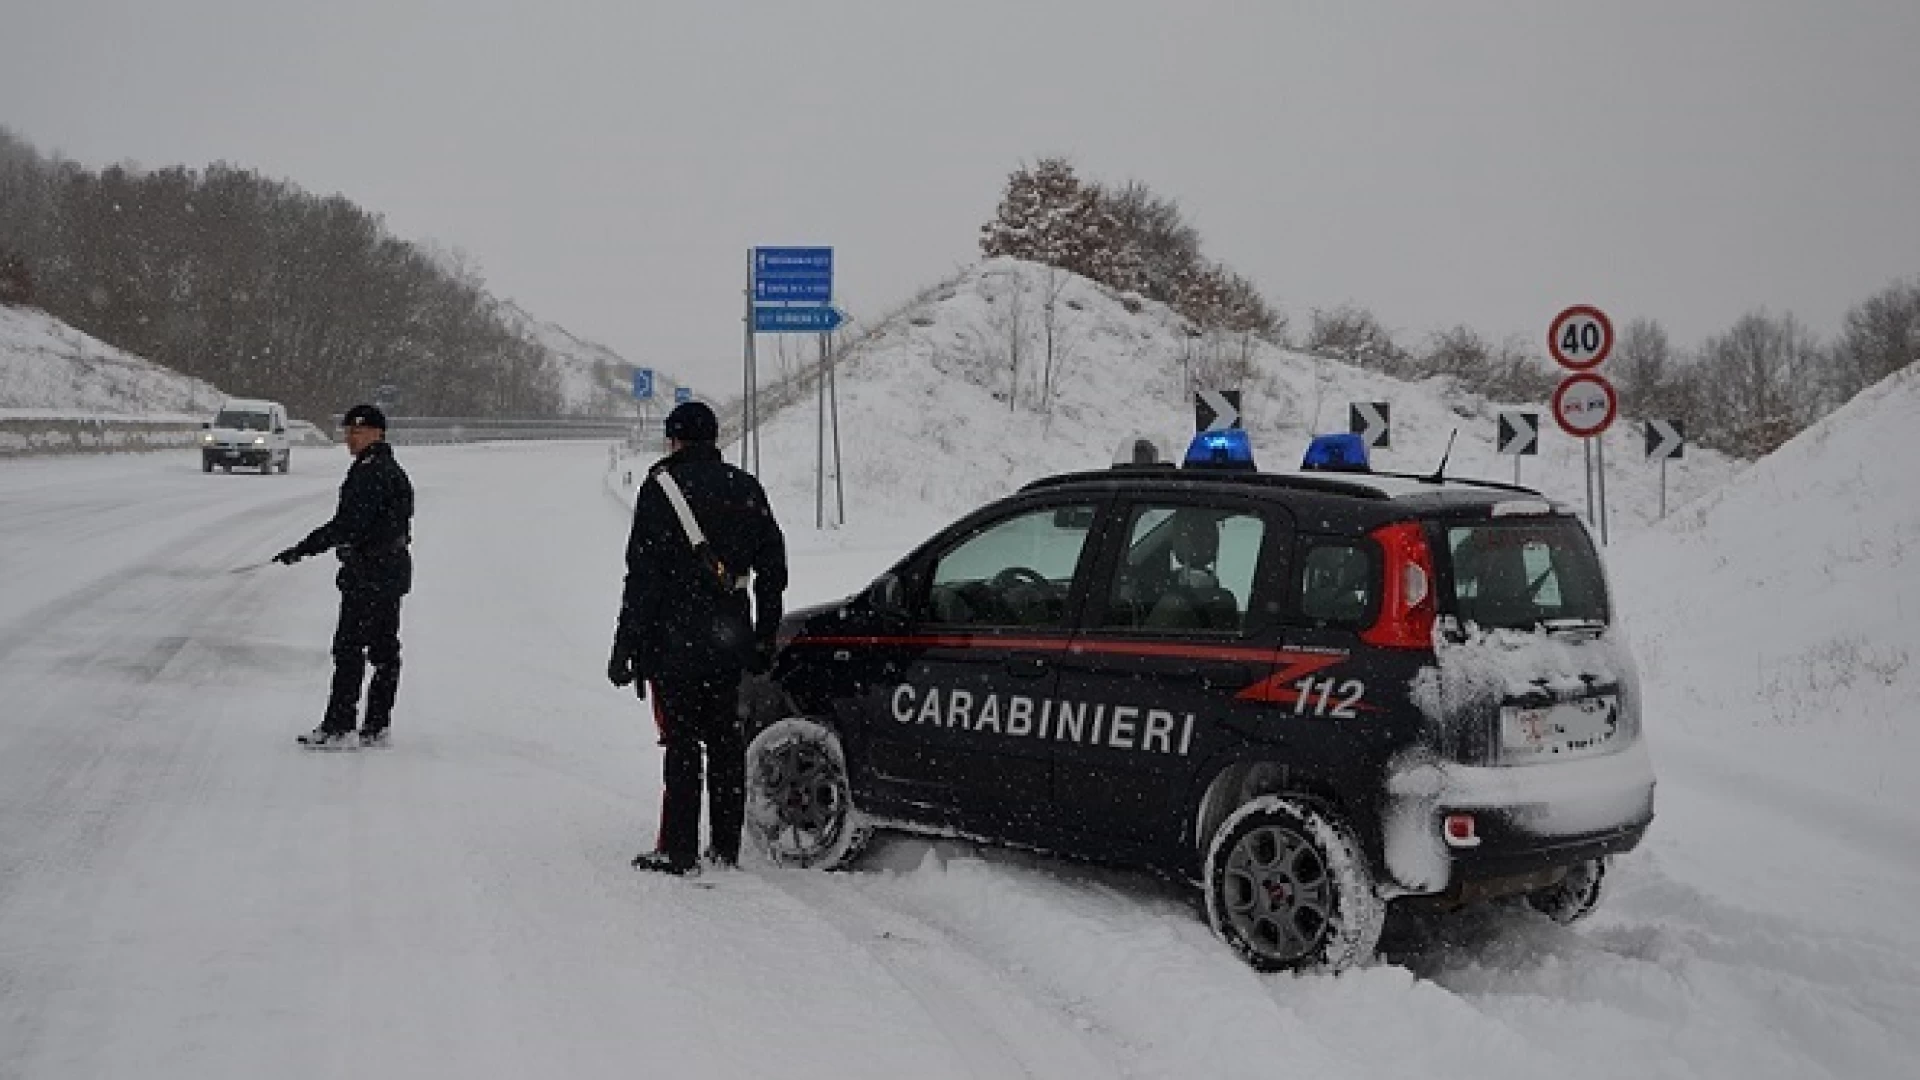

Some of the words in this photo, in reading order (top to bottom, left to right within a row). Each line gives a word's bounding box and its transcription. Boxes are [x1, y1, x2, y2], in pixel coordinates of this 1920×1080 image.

[1562, 321, 1600, 353] 40
[892, 682, 1196, 756] CARABINIERI
[1294, 676, 1365, 719] 112
